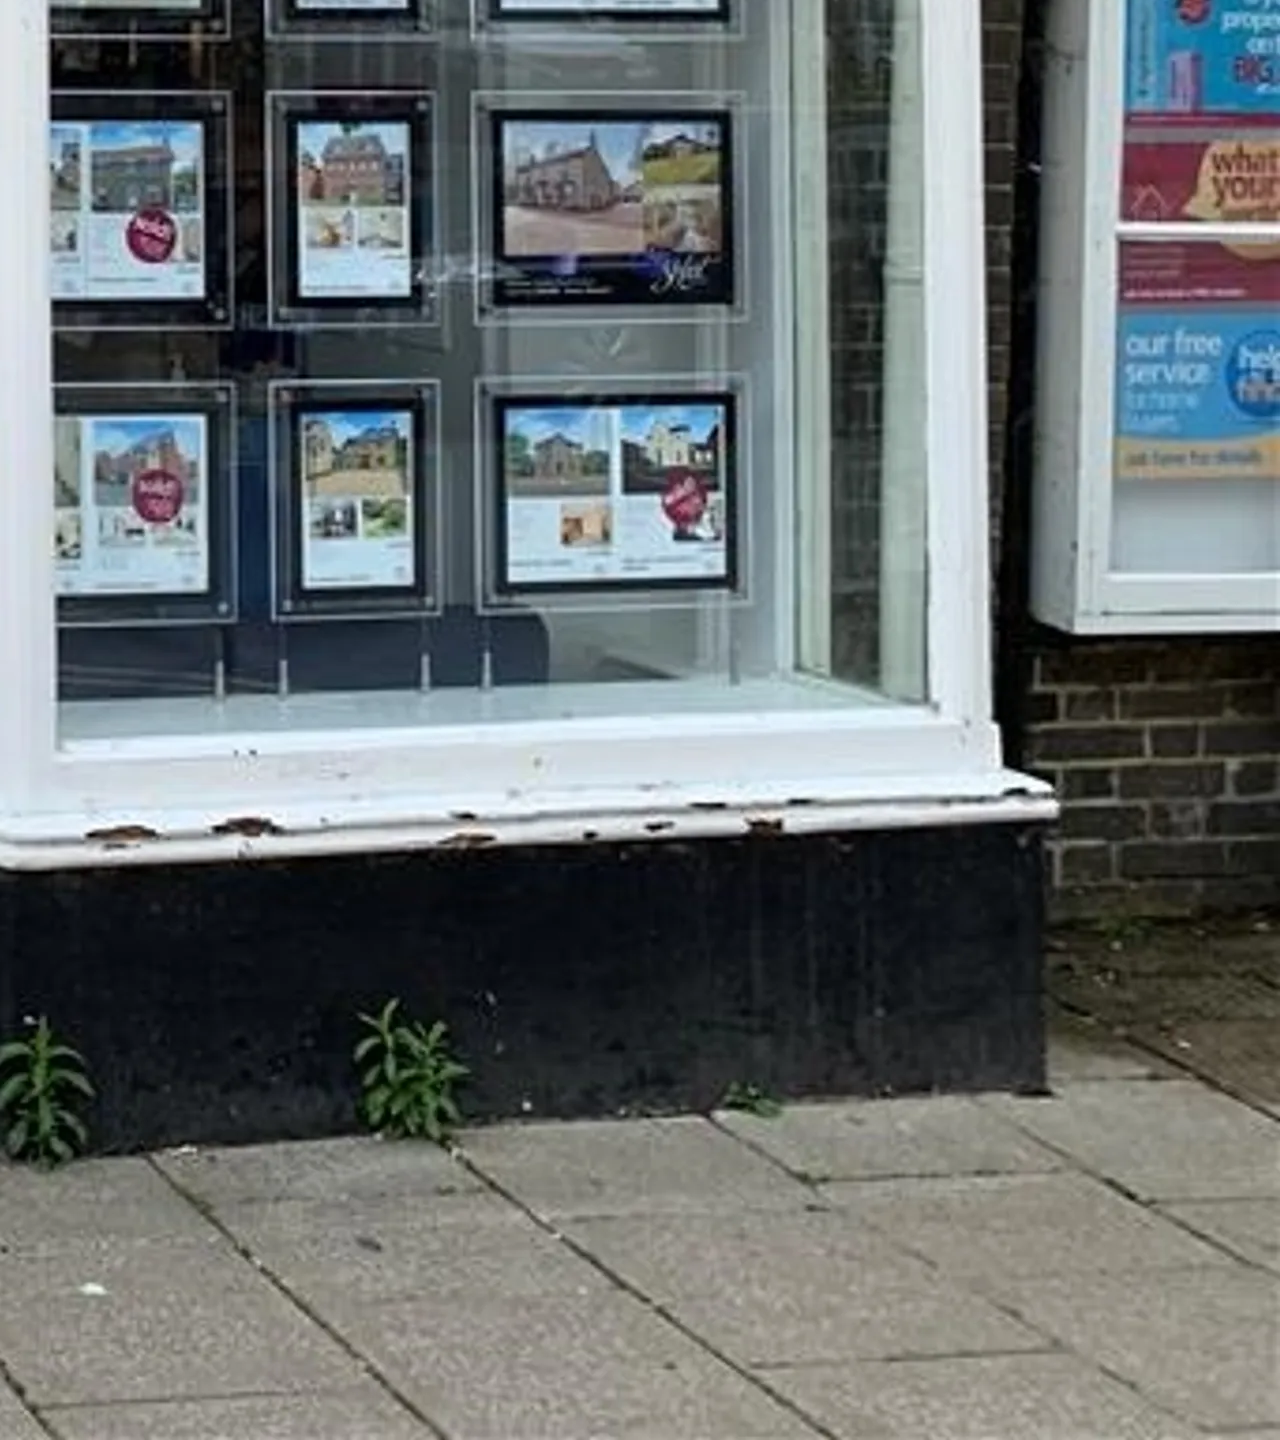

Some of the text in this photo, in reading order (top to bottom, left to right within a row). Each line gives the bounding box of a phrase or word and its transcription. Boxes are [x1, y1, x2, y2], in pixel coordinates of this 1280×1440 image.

[1126, 328, 1222, 357] our free
[1125, 362, 1212, 385] service
